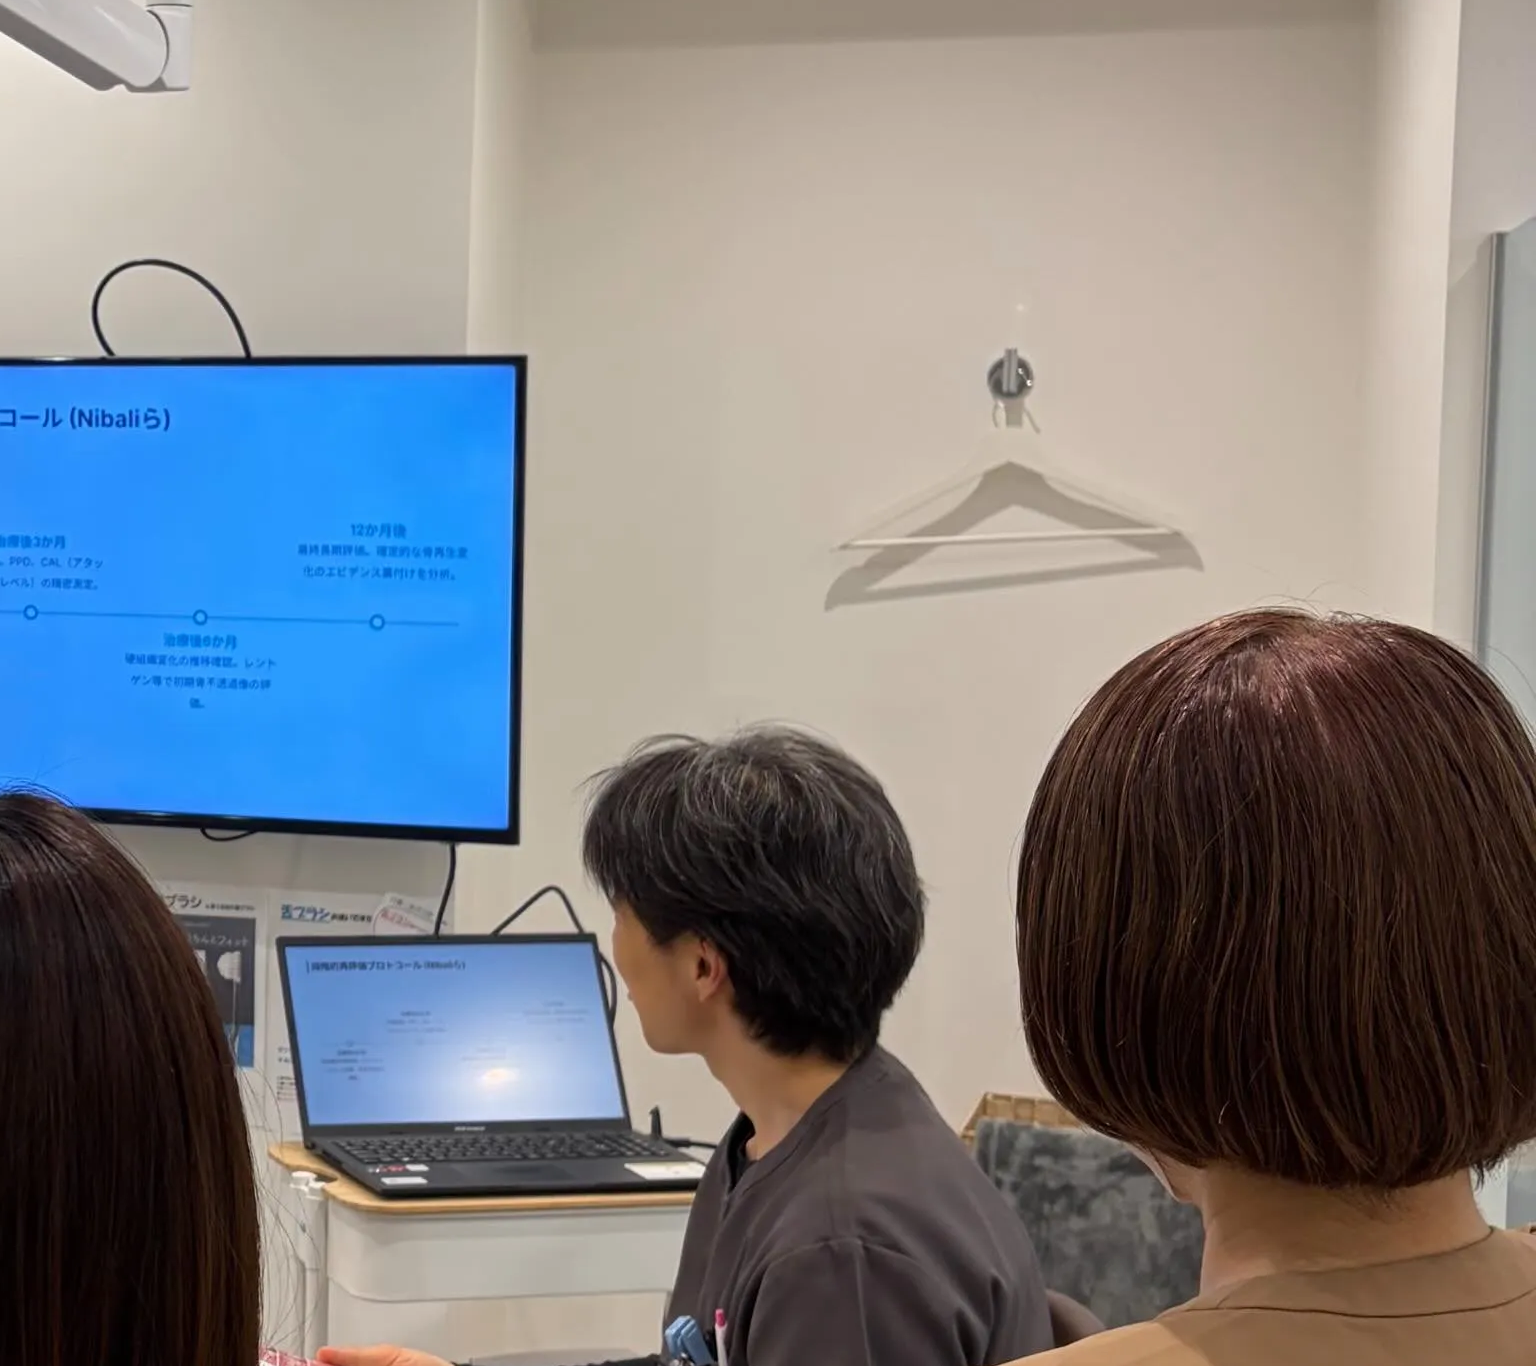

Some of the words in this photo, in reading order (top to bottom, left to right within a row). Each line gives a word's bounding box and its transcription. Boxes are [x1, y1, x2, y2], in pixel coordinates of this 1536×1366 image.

[69, 407, 171, 431] (Nibaliら)
[350, 523, 407, 539] 12か月後
